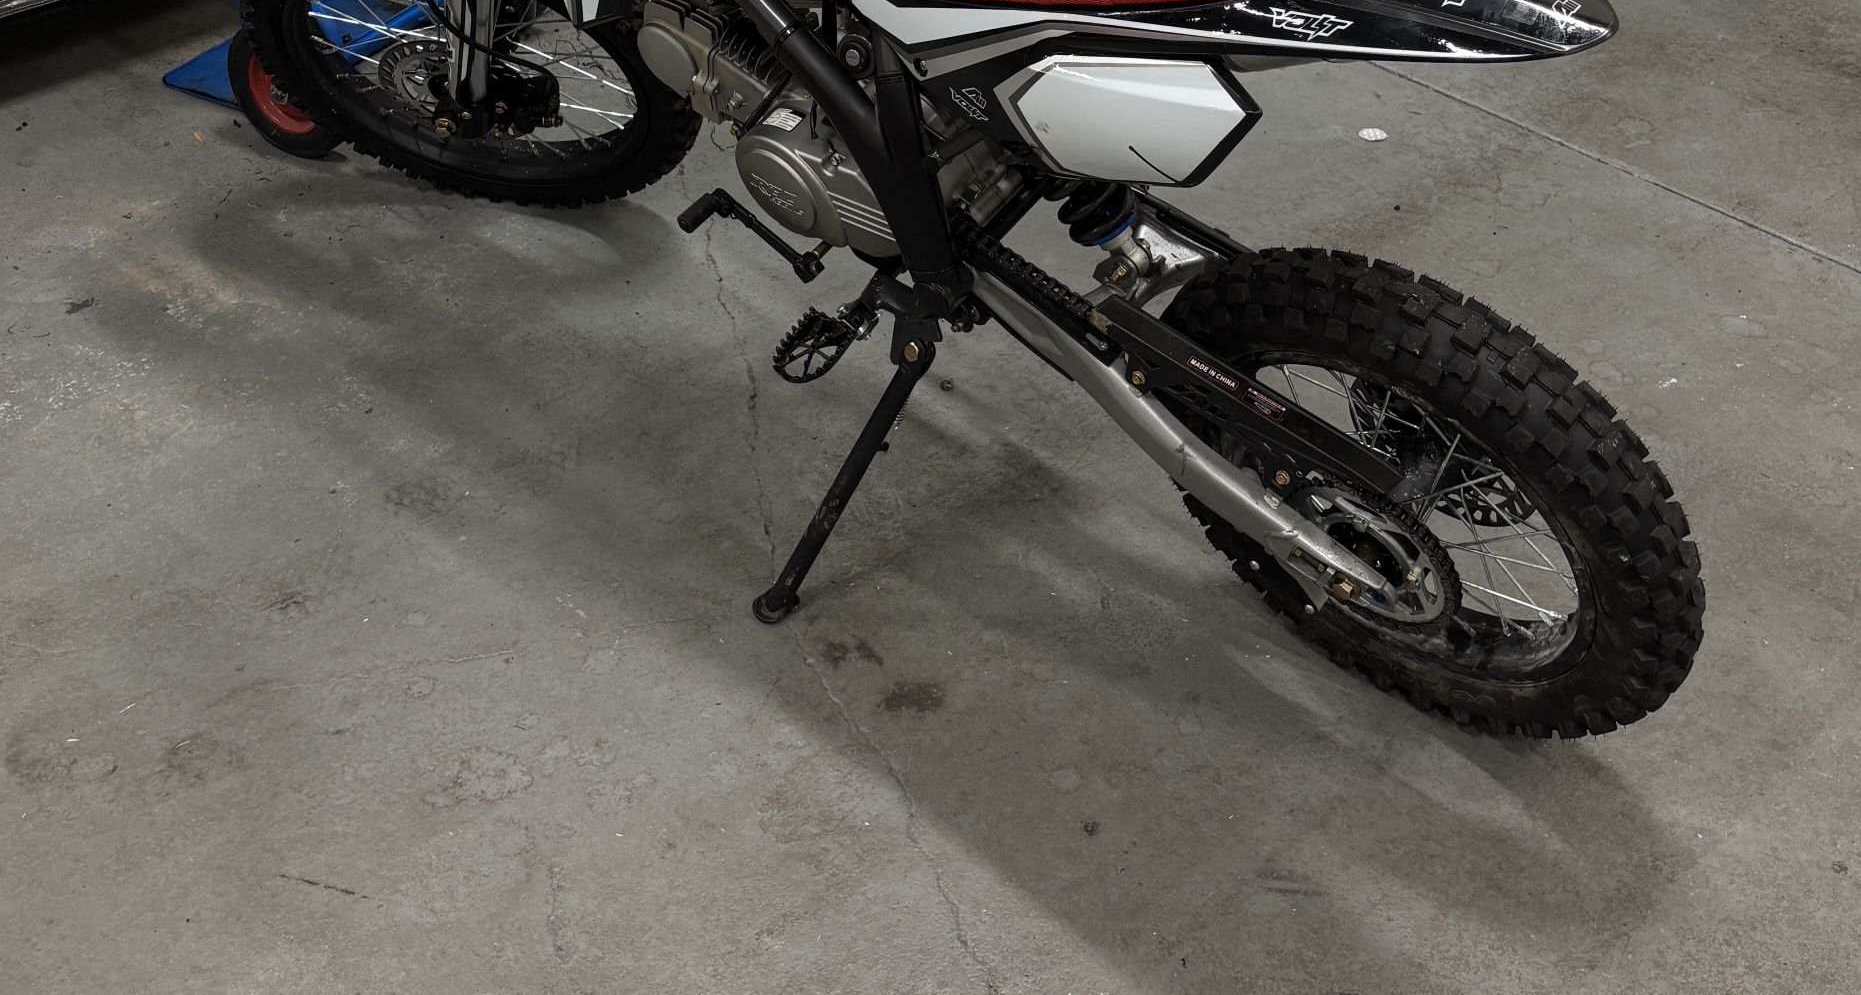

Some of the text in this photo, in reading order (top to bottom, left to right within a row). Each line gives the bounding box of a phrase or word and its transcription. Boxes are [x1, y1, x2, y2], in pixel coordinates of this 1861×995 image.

[1268, 6, 1355, 42] VOLT
[948, 86, 989, 121] VOLT
[1190, 358, 1236, 388] MADE IN CHINA
